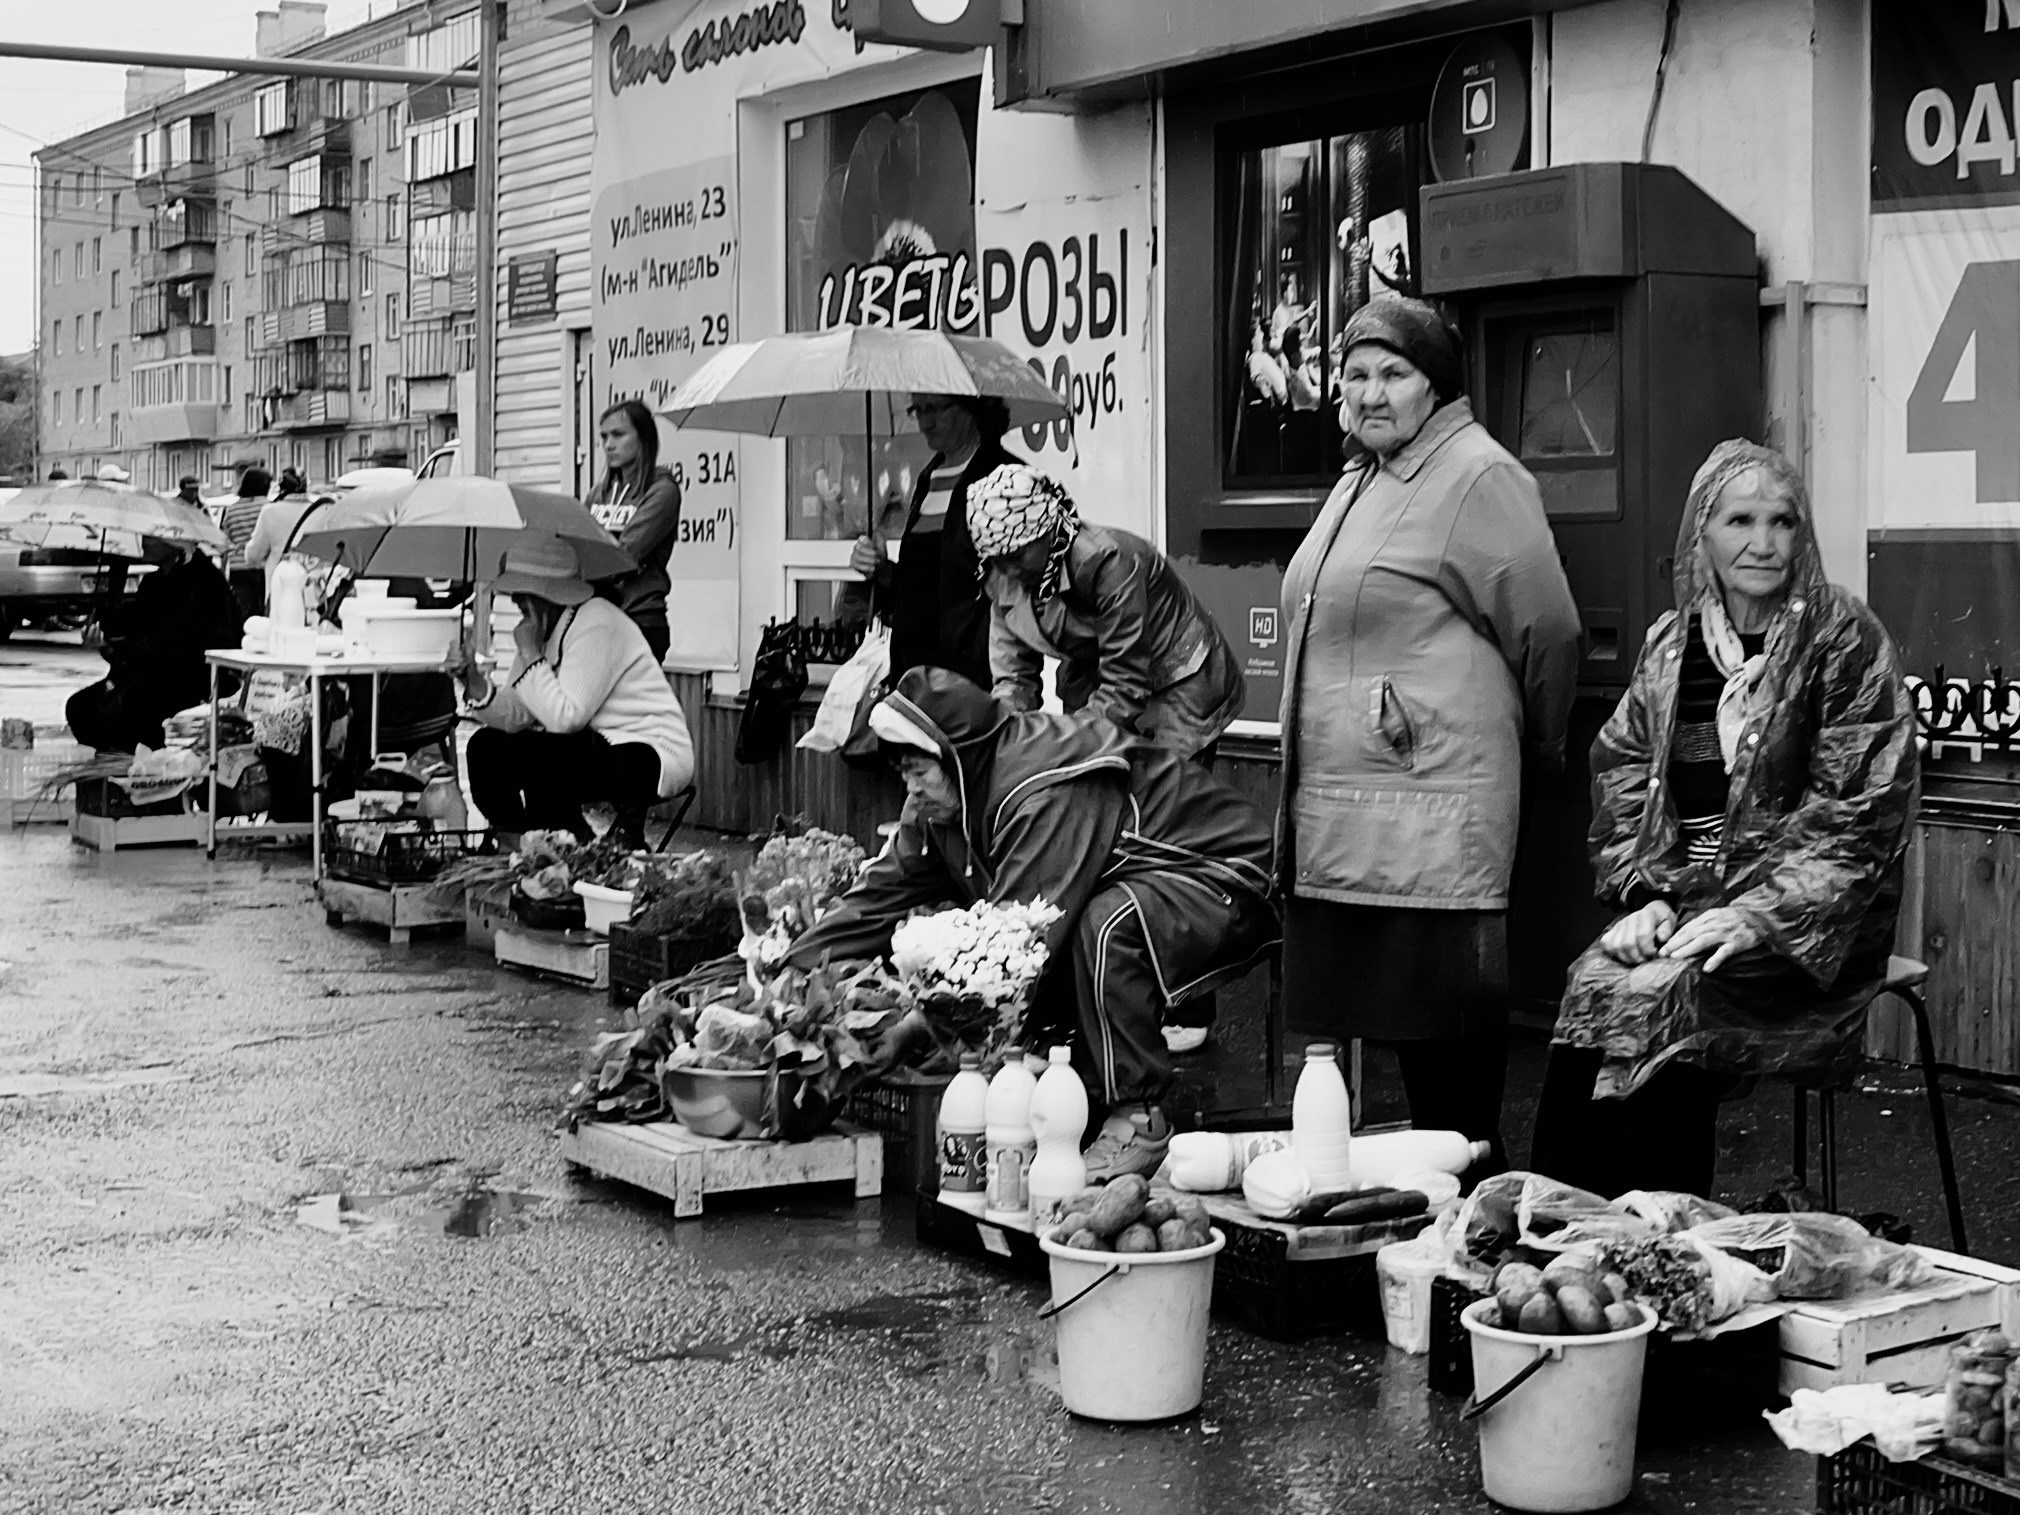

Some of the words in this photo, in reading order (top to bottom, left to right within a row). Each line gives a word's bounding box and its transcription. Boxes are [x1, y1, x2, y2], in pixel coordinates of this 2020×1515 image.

[1905, 79, 2020, 179] ОД
[701, 185, 727, 220] 23
[601, 264, 638, 306] (м-н
[983, 228, 1128, 348] РОЗЫ
[702, 313, 730, 347] 29
[697, 450, 737, 484] 31А
[1254, 616, 1273, 635] HD
